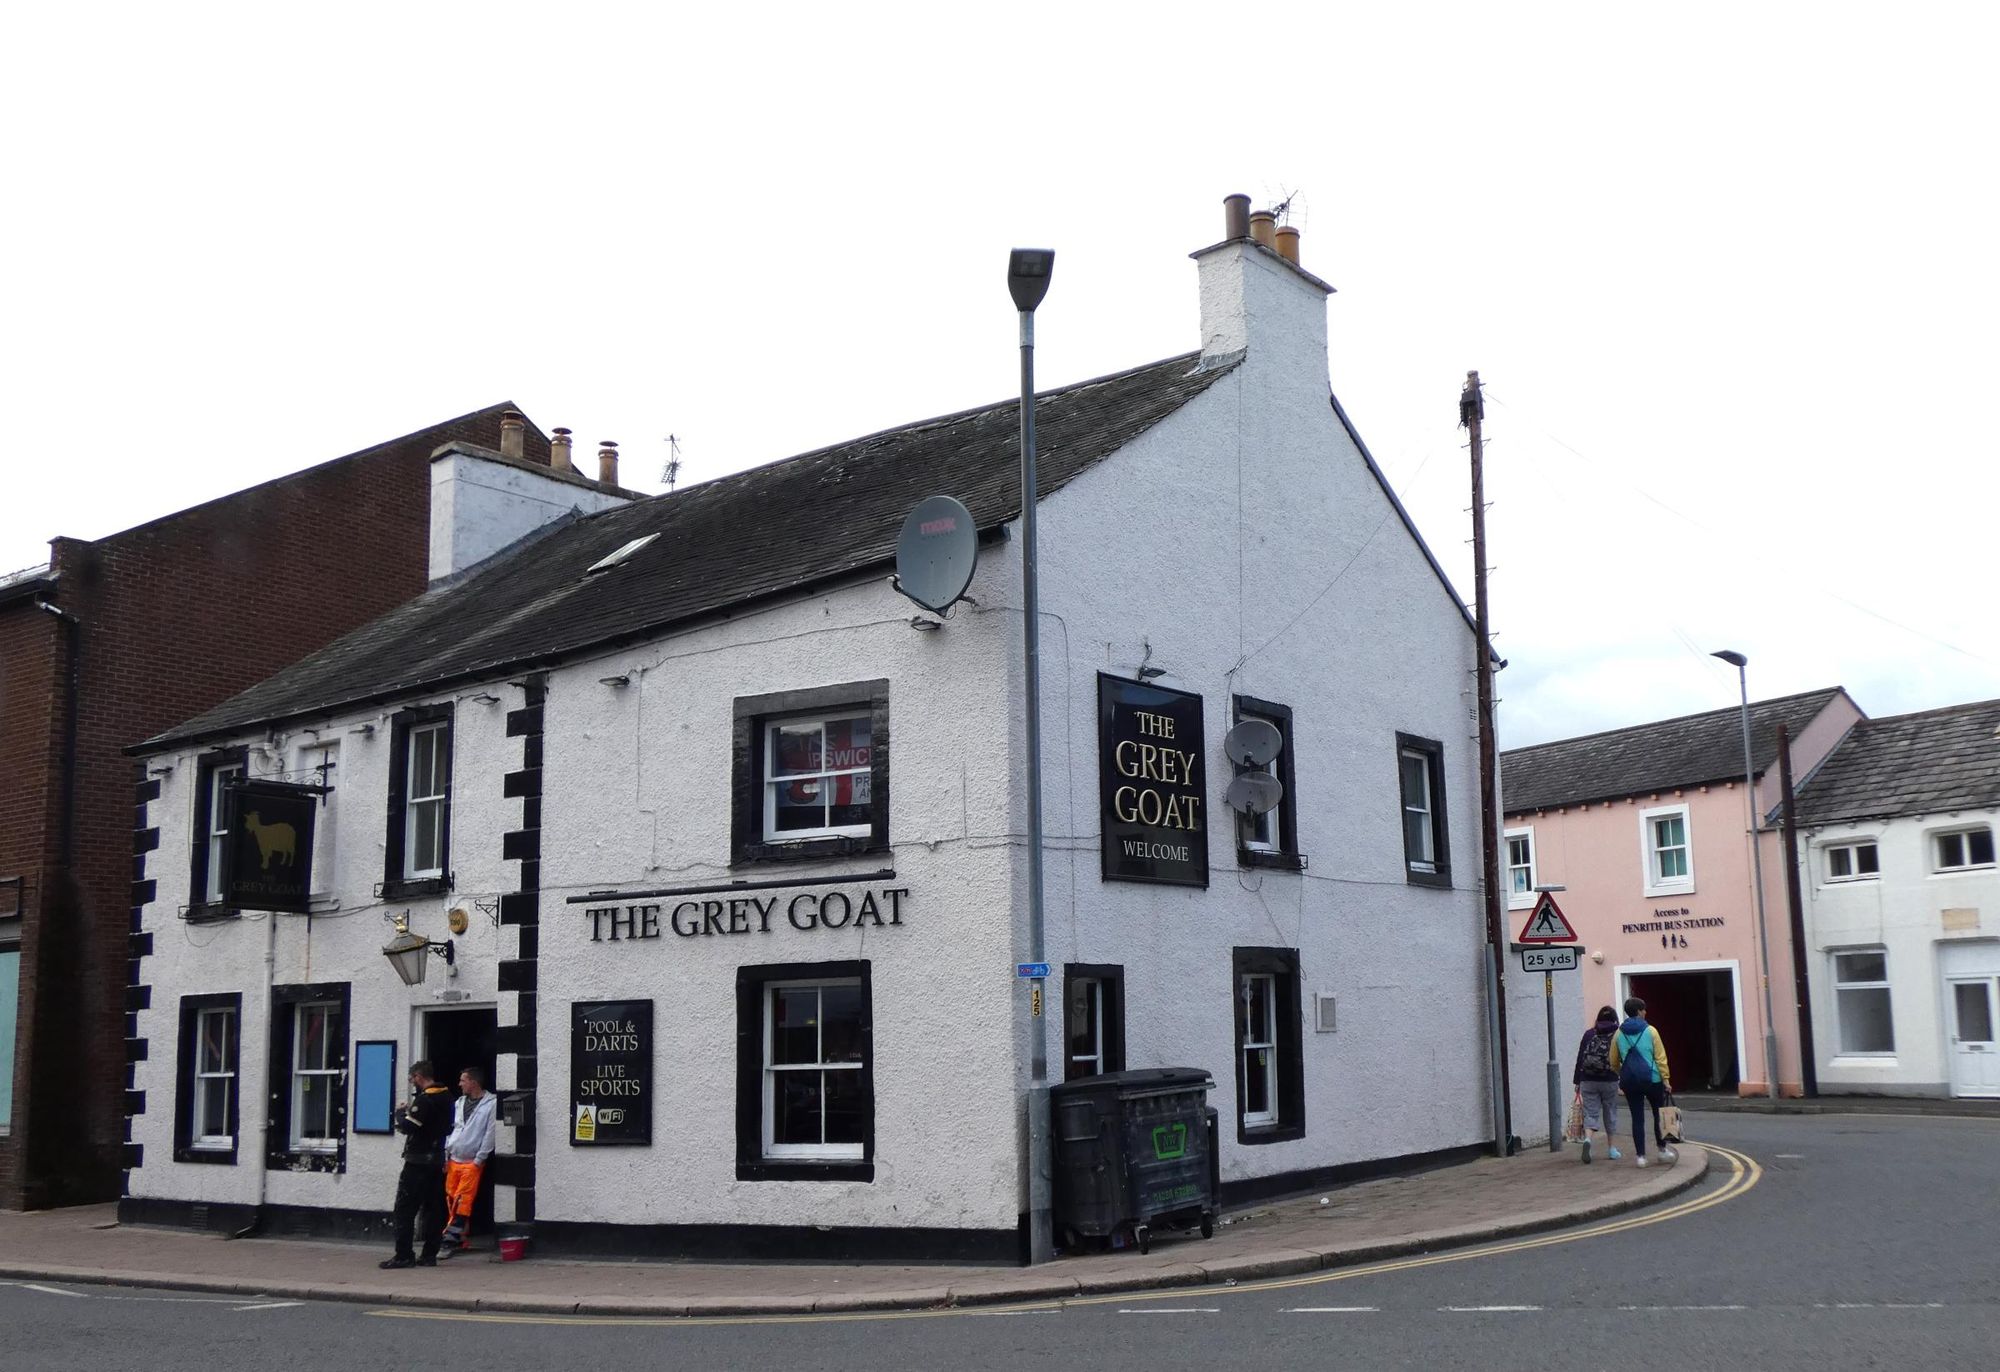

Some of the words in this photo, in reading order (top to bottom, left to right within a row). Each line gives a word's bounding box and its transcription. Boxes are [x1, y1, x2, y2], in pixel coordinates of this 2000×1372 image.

[1135, 711, 1175, 739] THE
[808, 748, 871, 768] IPSWIC
[1115, 740, 1195, 786] GREY
[1115, 786, 1199, 830] GOAT
[1123, 840, 1189, 861] WELCOME
[585, 905, 660, 942] THE
[671, 896, 777, 937] GREY
[787, 888, 909, 930] GOAT
[1653, 908, 1679, 918] Access
[1681, 907, 1689, 915] to
[1622, 921, 1662, 933] PENRITH
[1664, 920, 1682, 930] BUS
[1683, 916, 1724, 928] STATION
[1527, 955, 1544, 965] 25
[1550, 953, 1571, 966] yds
[588, 1020, 622, 1035] POOL
[625, 1019, 635, 1033] &
[585, 1034, 639, 1051] DARTS
[597, 1065, 625, 1078] LIVE
[581, 1079, 640, 1096] SPORTS
